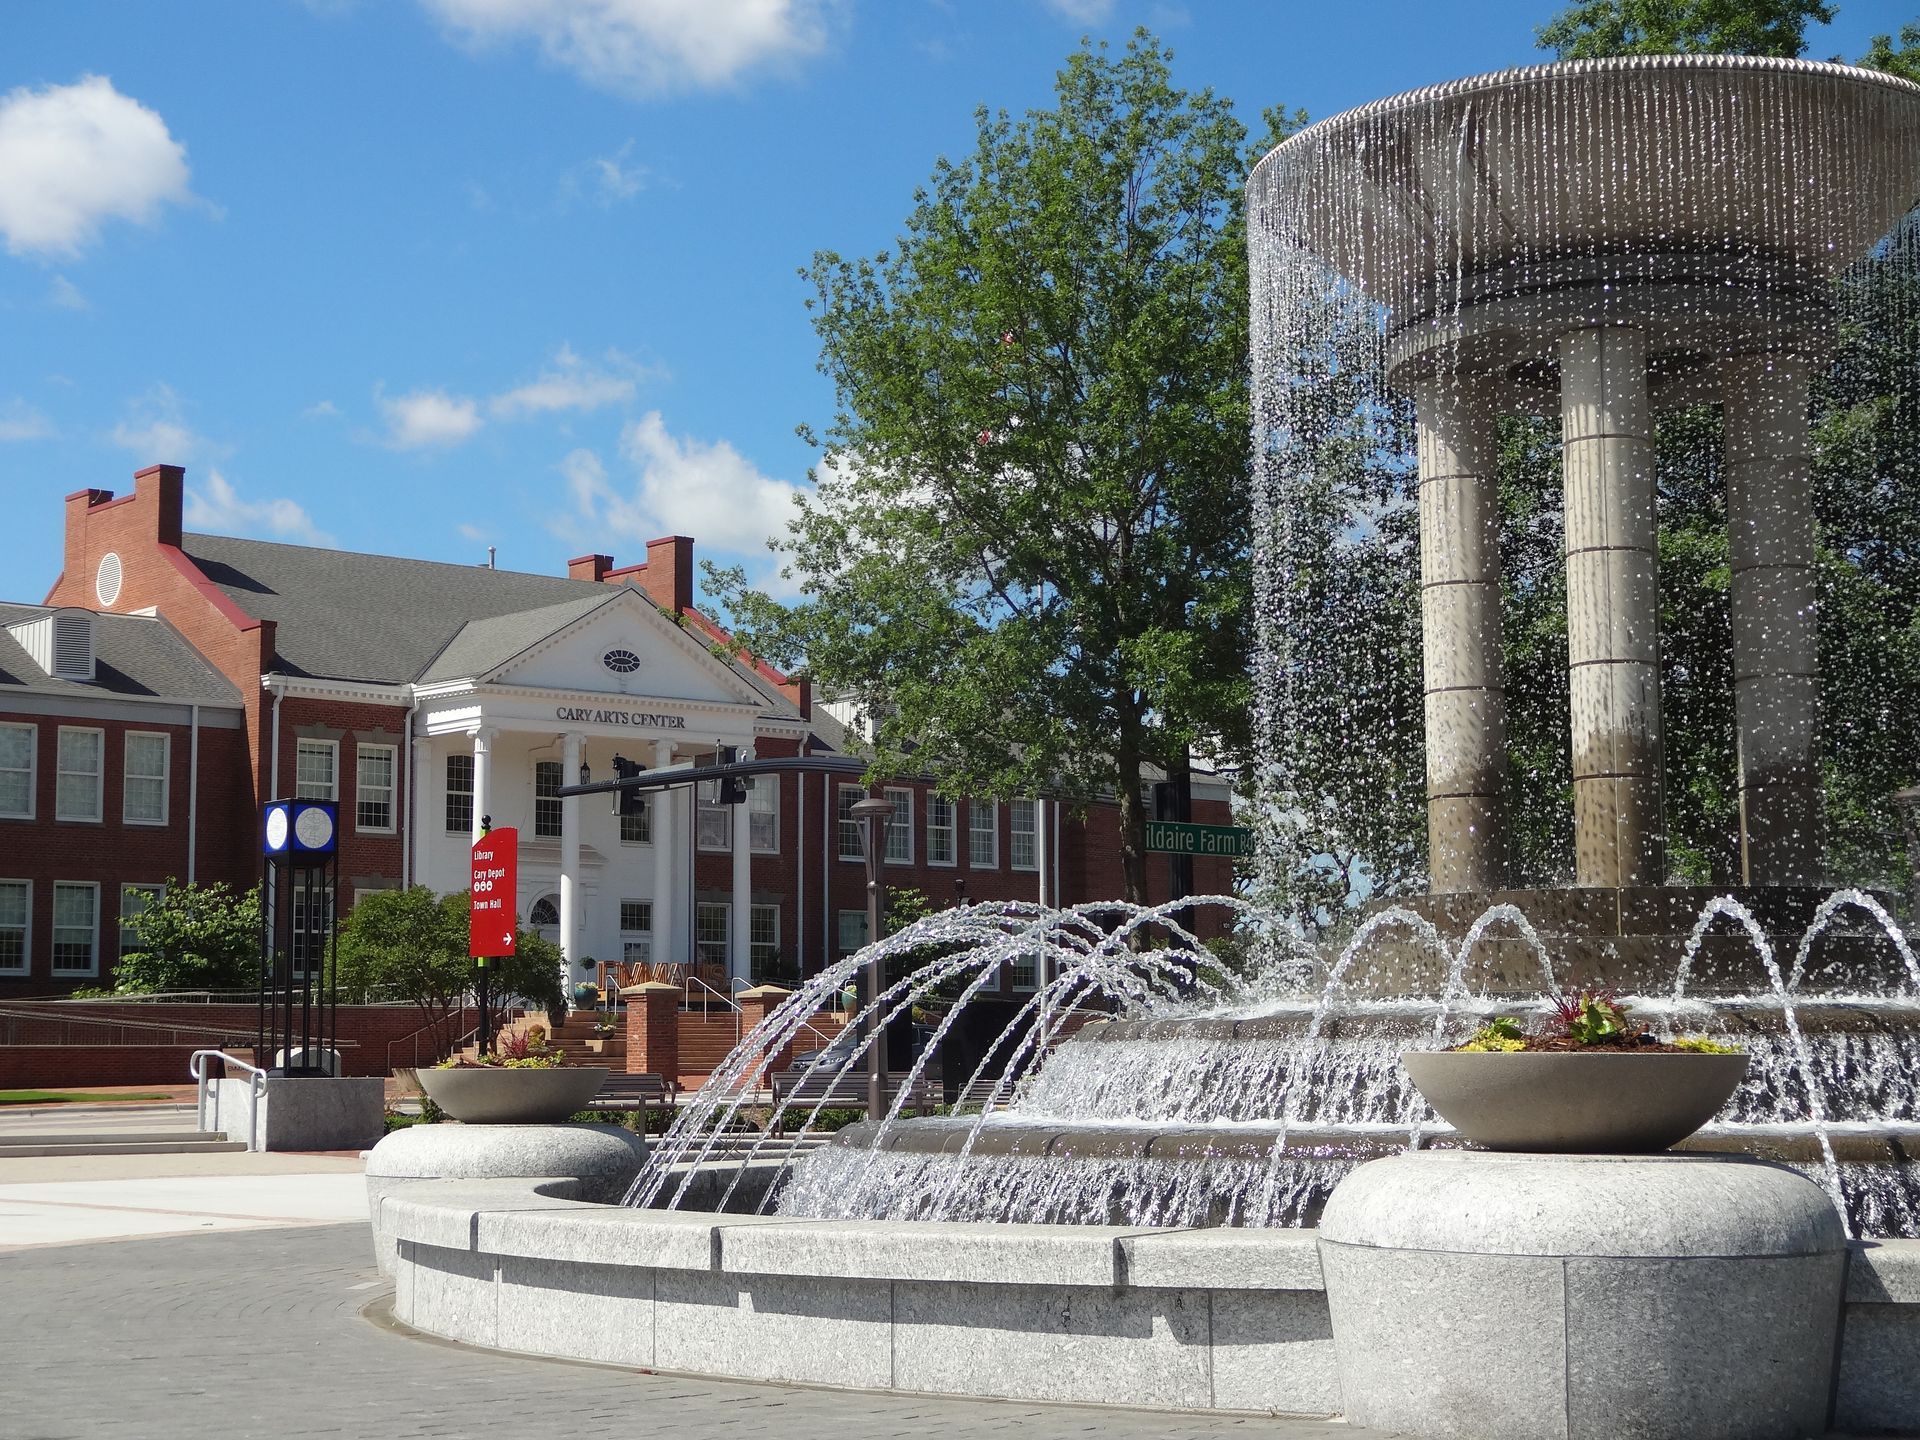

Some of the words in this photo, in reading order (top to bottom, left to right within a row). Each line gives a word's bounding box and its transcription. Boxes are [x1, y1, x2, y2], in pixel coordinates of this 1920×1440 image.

[556, 707, 593, 721] CARY
[594, 710, 629, 725] ARTS
[631, 712, 685, 729] CENTER
[1145, 823, 1194, 851] ildaire
[1200, 829, 1236, 853] Farm
[474, 850, 494, 862] Library
[473, 870, 487, 881] Cary
[487, 868, 505, 880] Depot
[473, 900, 489, 910] Town
[489, 898, 502, 909] Hall
